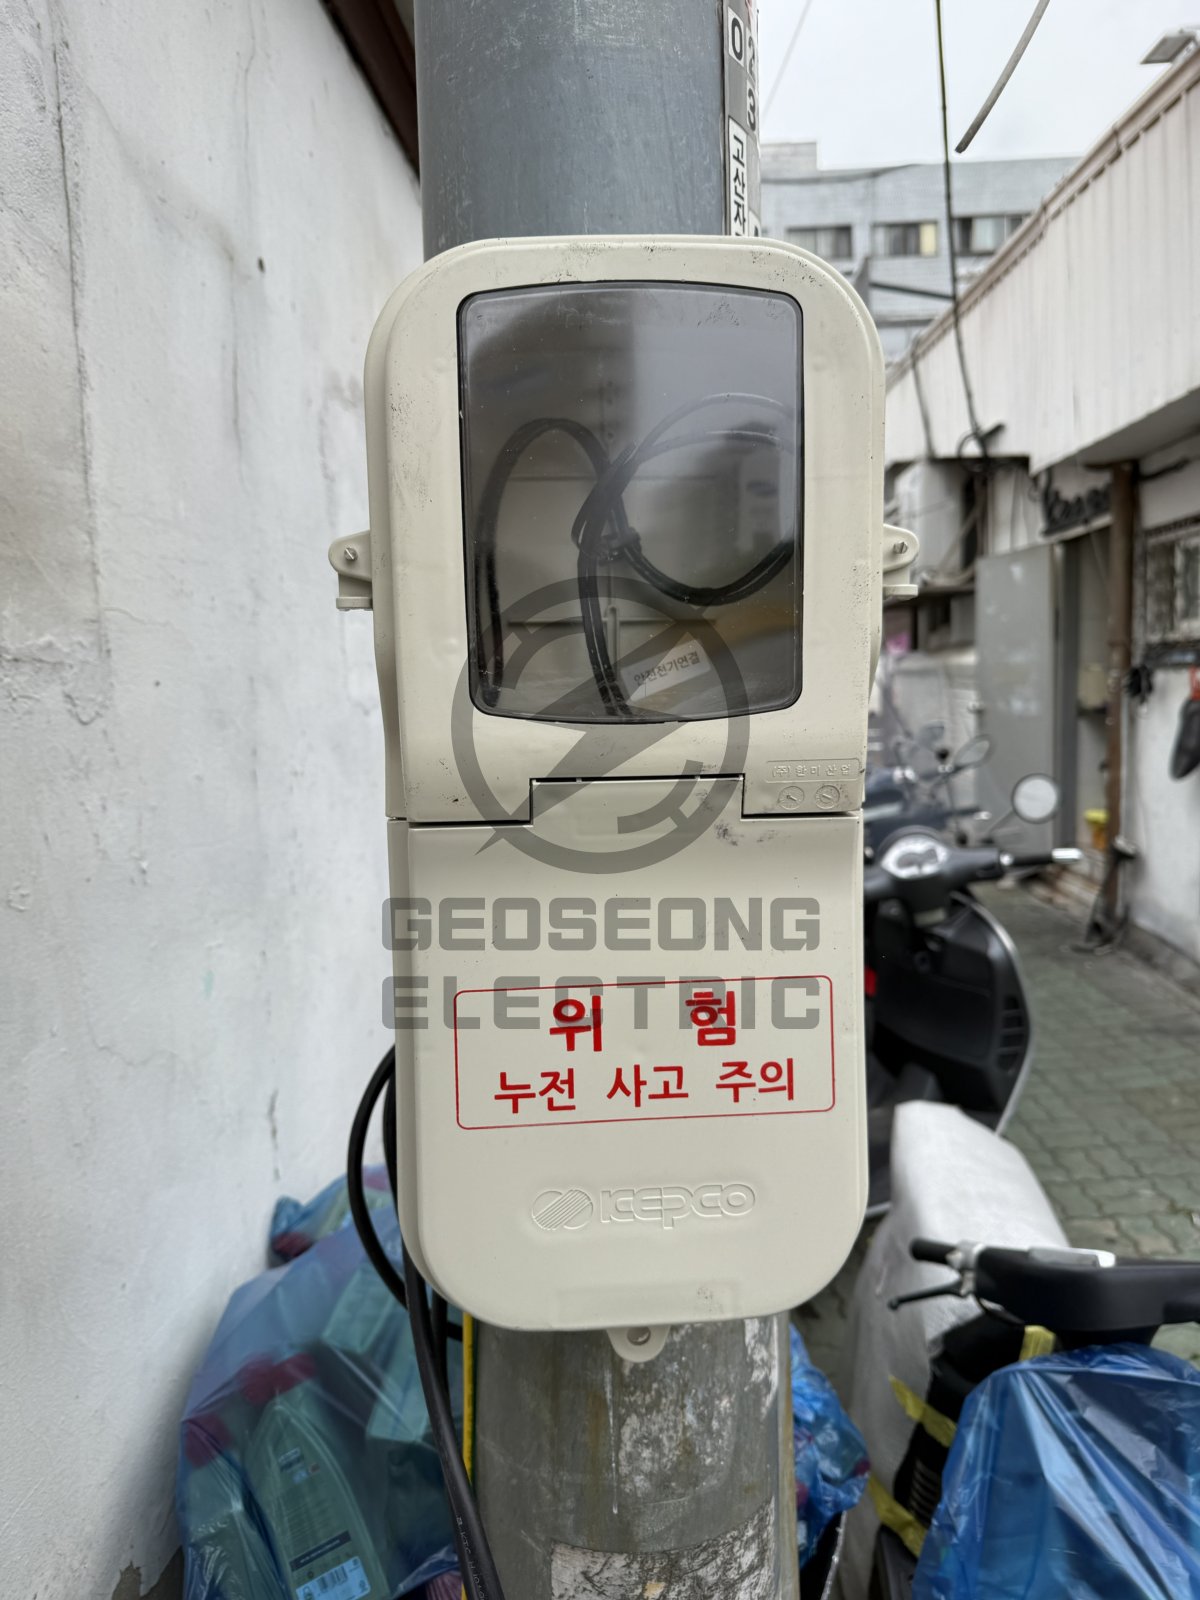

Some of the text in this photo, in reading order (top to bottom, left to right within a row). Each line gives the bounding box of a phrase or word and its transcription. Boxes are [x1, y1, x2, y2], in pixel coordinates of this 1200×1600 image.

[732, 134, 747, 236] 고산자
[494, 1058, 795, 1114] 누전 사고 주의
[600, 1184, 756, 1230] KEPCO
